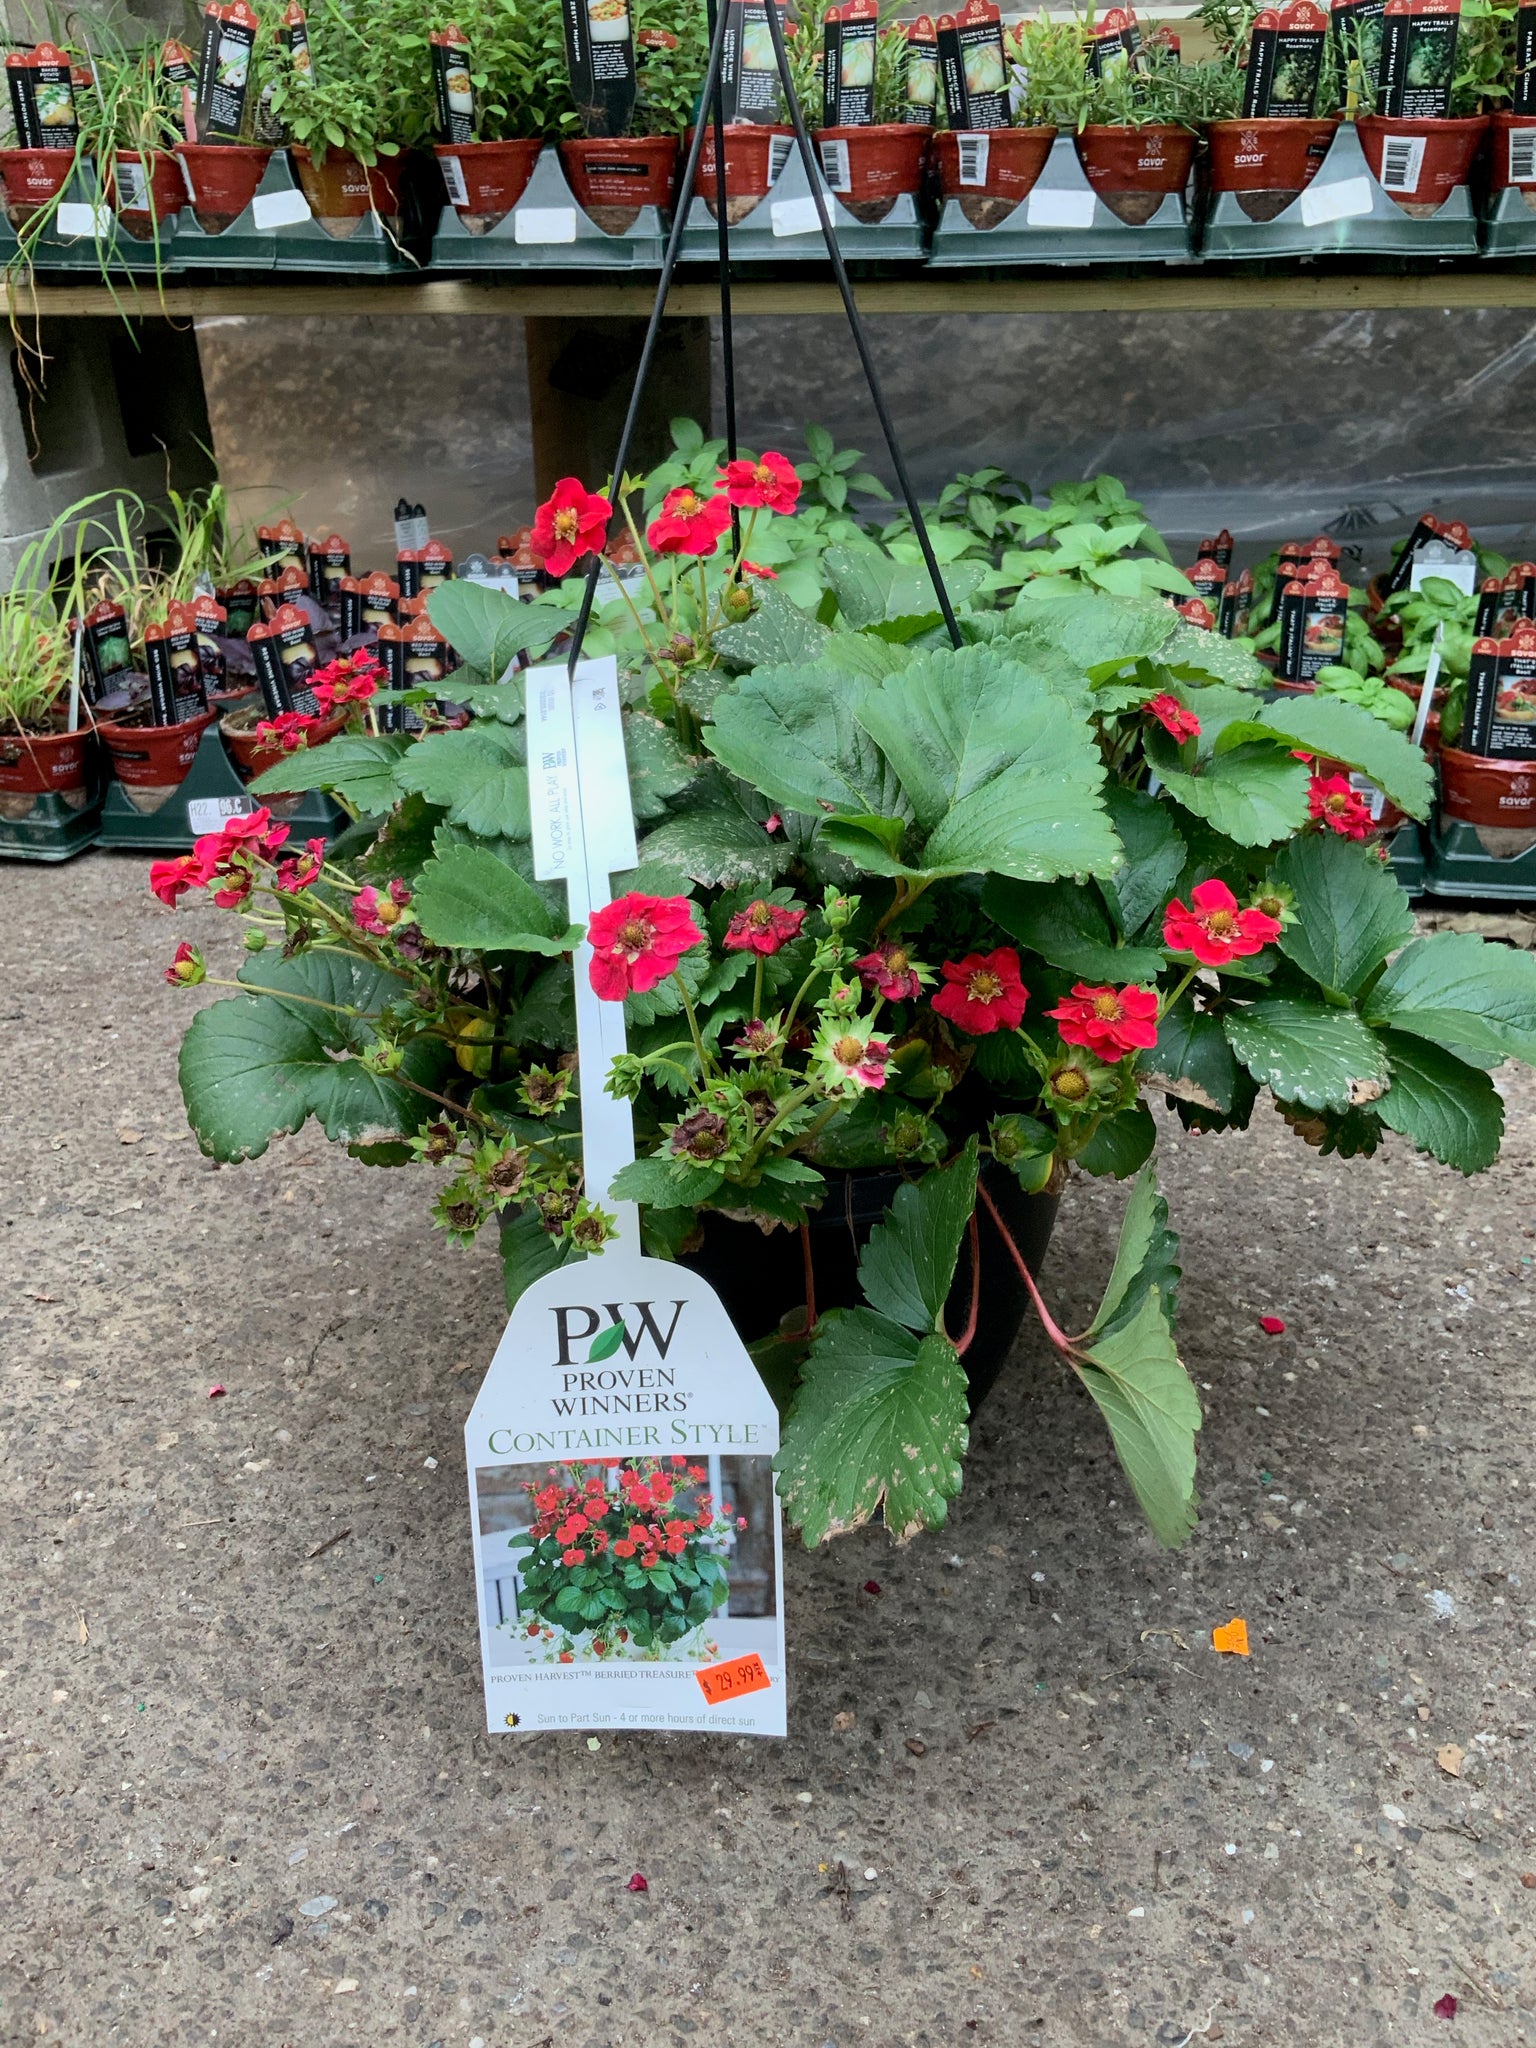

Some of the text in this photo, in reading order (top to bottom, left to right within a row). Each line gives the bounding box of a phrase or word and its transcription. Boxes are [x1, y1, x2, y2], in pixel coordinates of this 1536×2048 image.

[966, 15, 989, 24] savor
[960, 30, 984, 39] LICORICE
[1387, 27, 1398, 81] HAPPY TRAILS
[950, 58, 959, 91] LICORICE
[1253, 42, 1266, 95] HAPPY TRAILS
[21, 103, 29, 128] POTATO
[1137, 158, 1163, 166] savor
[1234, 153, 1264, 163] savor
[27, 178, 52, 186] savor
[52, 761, 79, 773] savor
[546, 775, 559, 795] PLAY
[548, 798, 560, 813] ALL
[1499, 796, 1532, 806] savor
[552, 851, 565, 870] NO
[548, 1300, 689, 1366] PW
[562, 1368, 676, 1392] PROVEN
[488, 1426, 662, 1454] CONTAINER
[491, 1674, 532, 1684] PROVEN
[595, 1670, 637, 1680] BERRIED
[538, 1714, 556, 1724] Sun
[560, 1714, 568, 1723] to
[571, 1713, 589, 1723] Part
[593, 1713, 610, 1722] Sun
[620, 1713, 626, 1722] 4
[641, 1715, 665, 1723] more
[668, 1713, 694, 1724] hours
[697, 1714, 706, 1724] of
[709, 1714, 736, 1725] direct
[739, 1718, 755, 1726] sun
